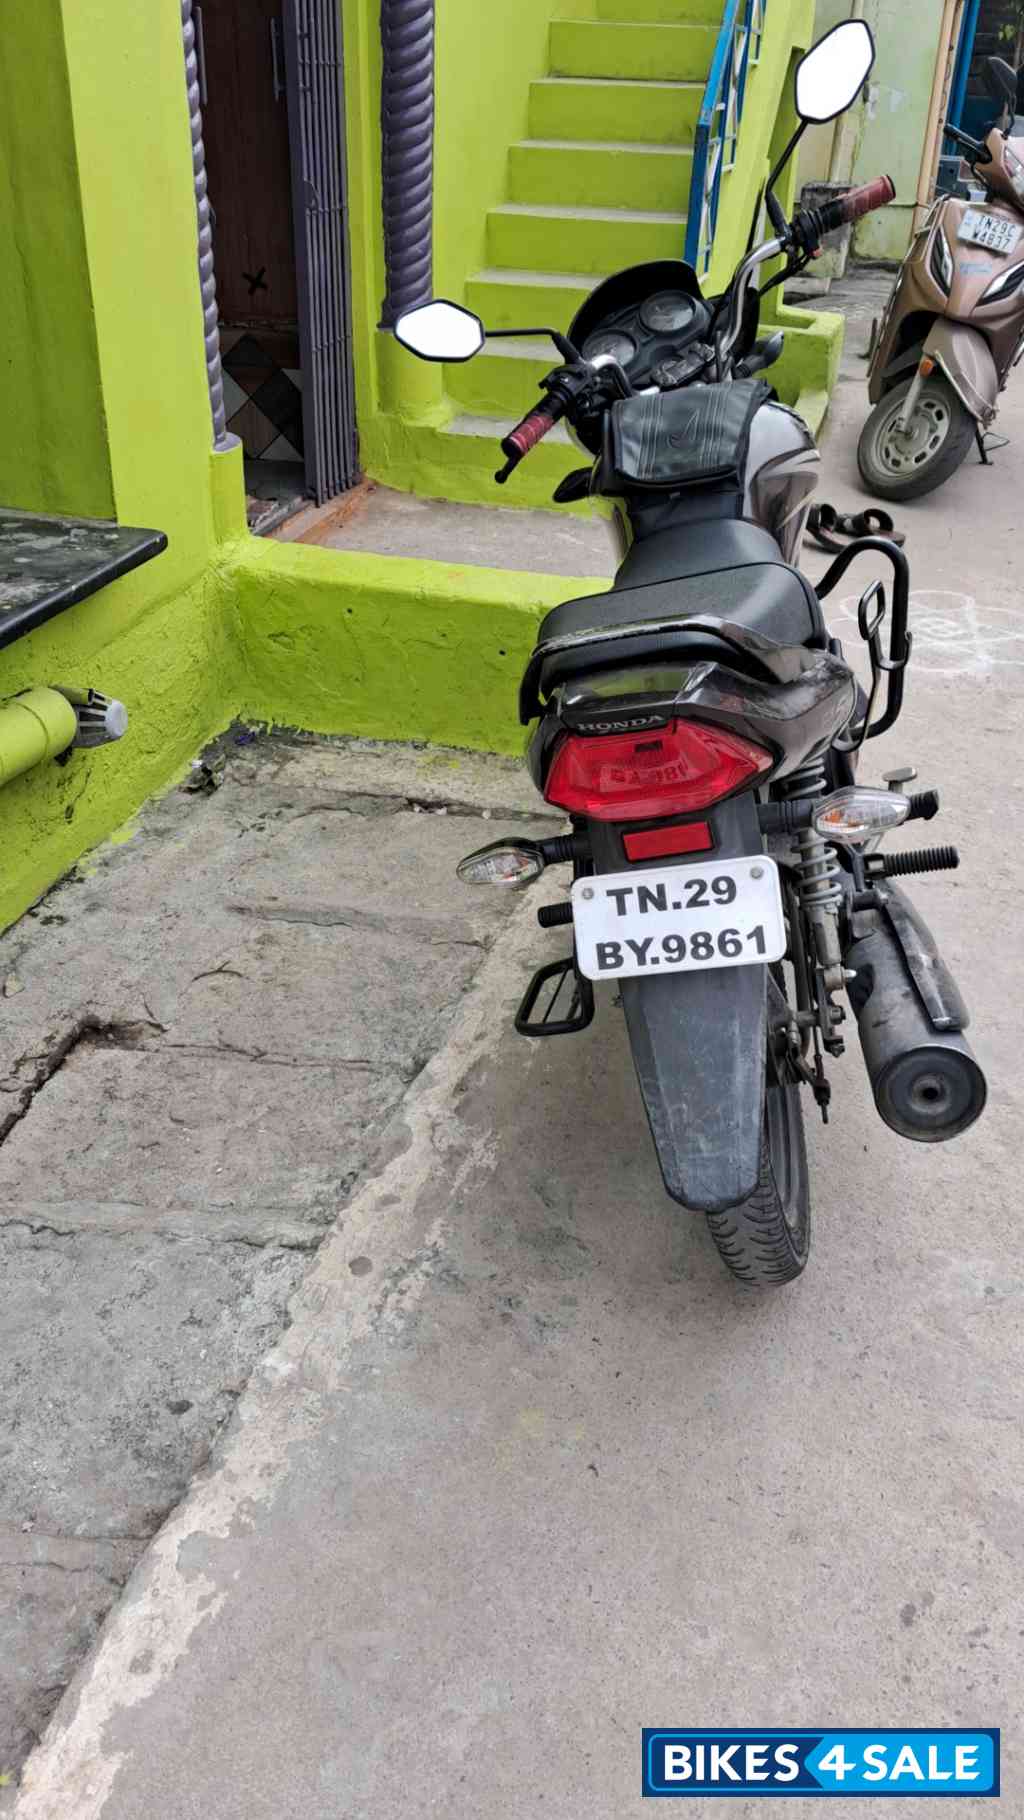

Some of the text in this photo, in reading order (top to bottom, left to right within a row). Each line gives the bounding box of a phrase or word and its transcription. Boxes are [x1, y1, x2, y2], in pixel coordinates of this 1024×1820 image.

[577, 714, 664, 731] HONDA
[606, 875, 737, 917] TN.29
[595, 925, 767, 970] BY.9861
